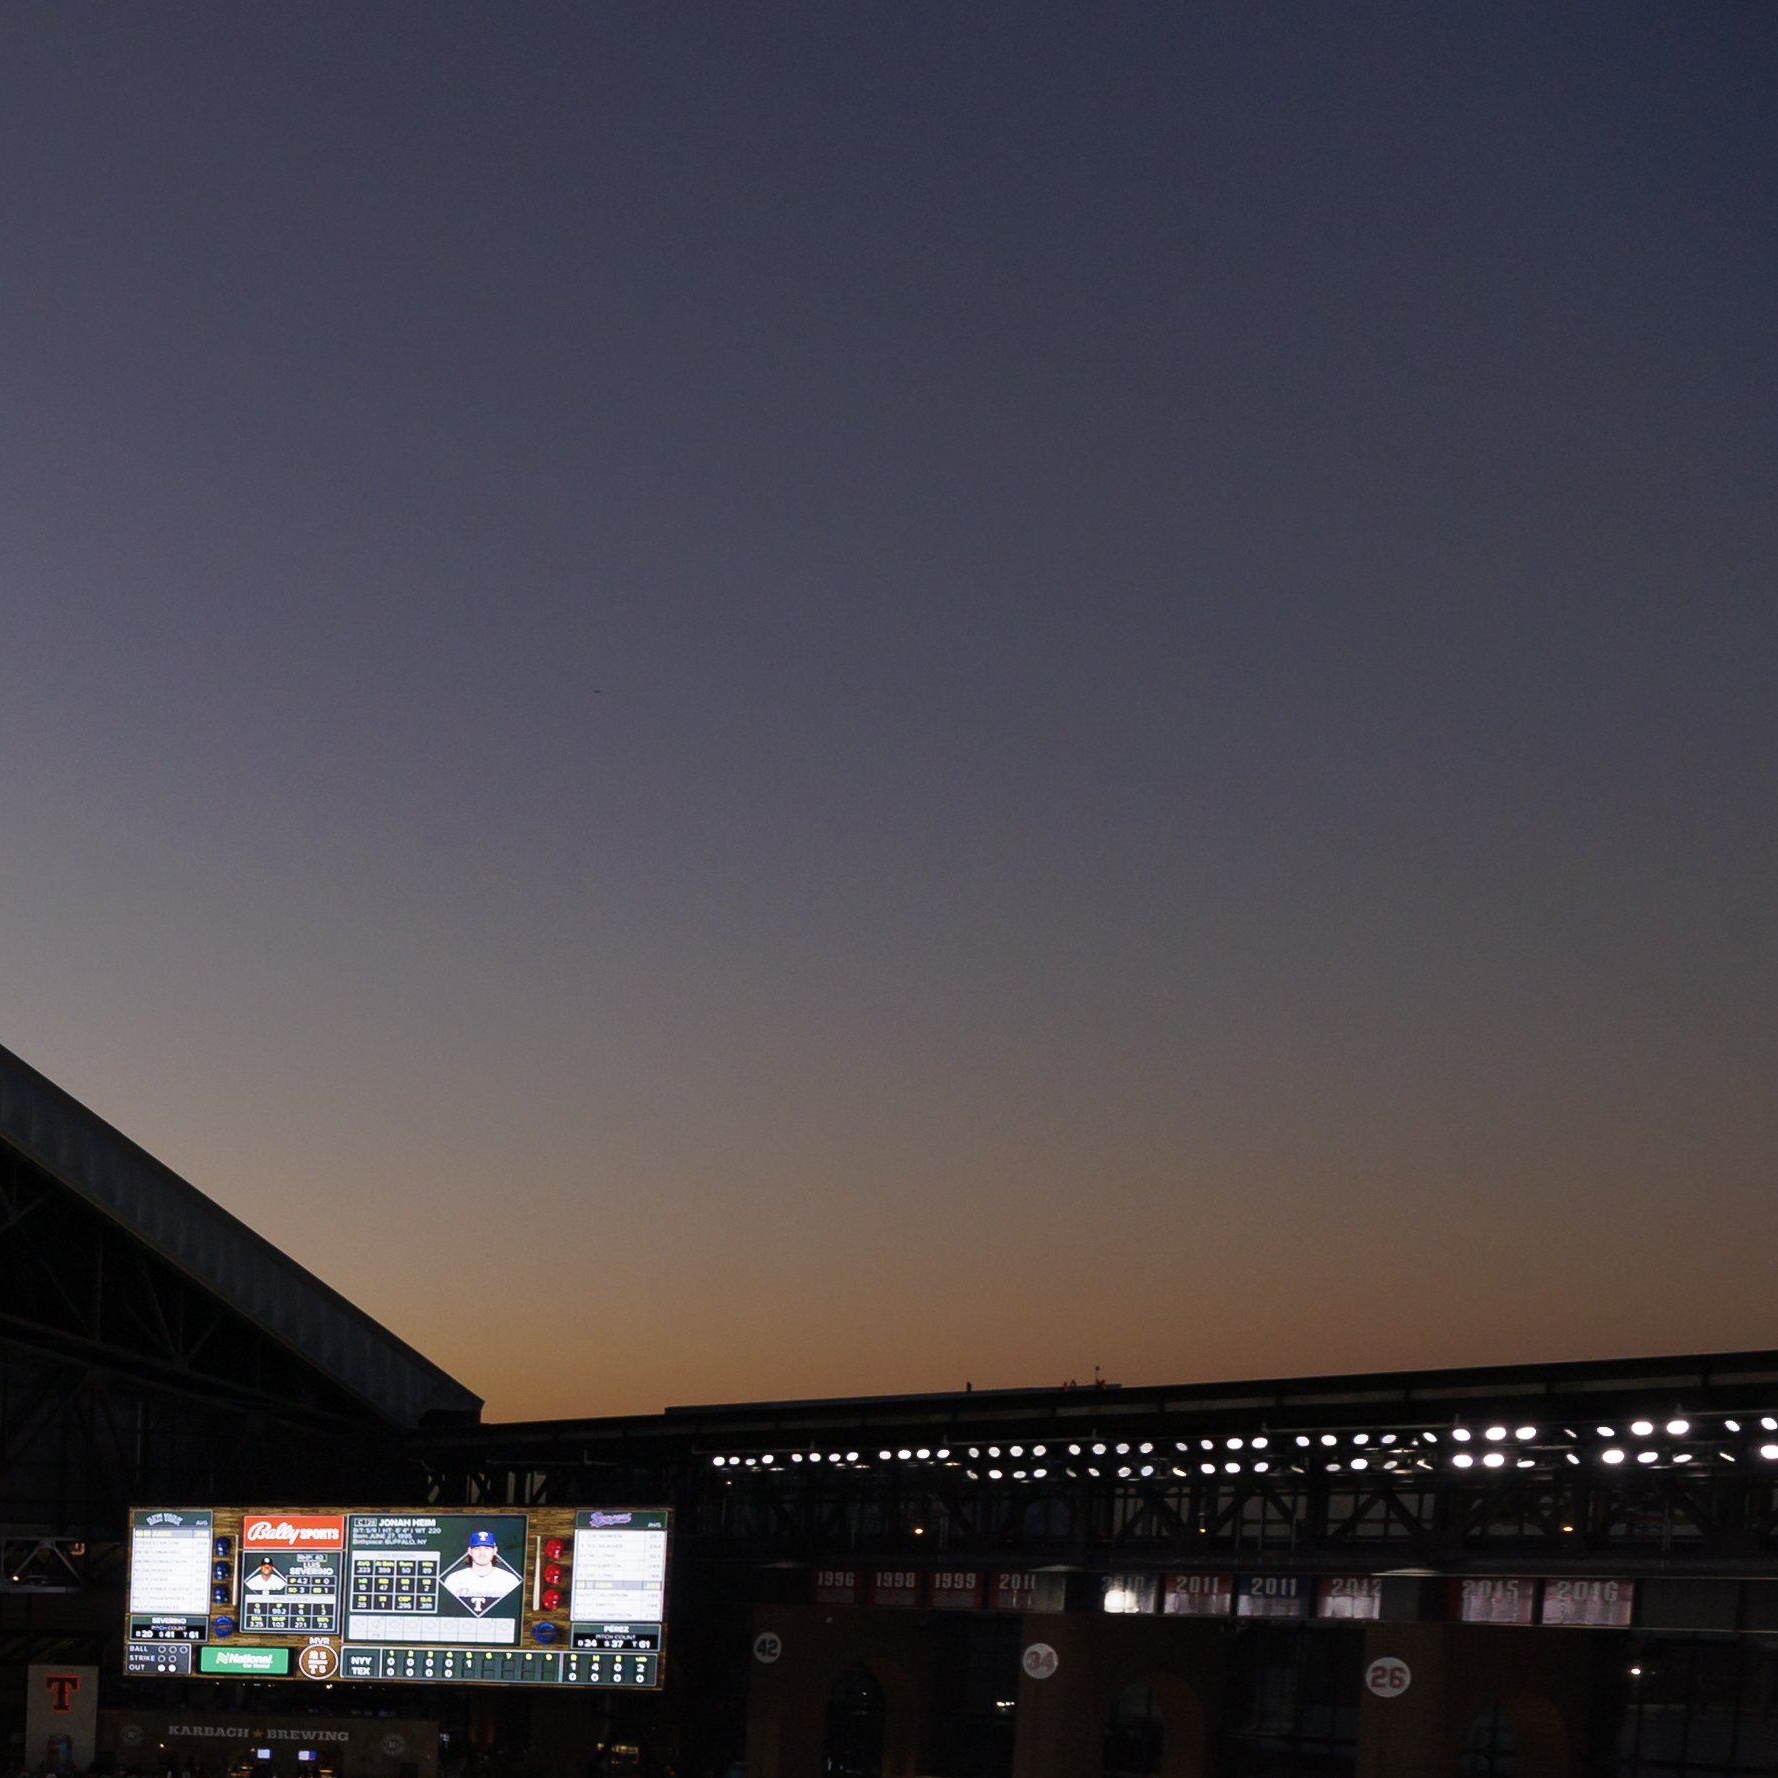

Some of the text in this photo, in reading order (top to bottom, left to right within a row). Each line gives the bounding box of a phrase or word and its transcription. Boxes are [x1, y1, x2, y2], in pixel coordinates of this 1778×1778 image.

[379, 1518, 412, 1527] JONAH
[412, 1518, 436, 1527] HEIM
[247, 1521, 340, 1545] Bally SPORTS
[817, 1571, 855, 1587] 1996
[876, 1572, 916, 1588] 1998
[935, 1572, 976, 1589] 1999
[1176, 1576, 1219, 1594] 2011
[1250, 1576, 1297, 1597] 2011
[1461, 1579, 1519, 1600] 2015
[1556, 1579, 1619, 1601] 2016
[151, 1617, 187, 1625] SEVERINO
[141, 1630, 154, 1638] 20
[164, 1630, 175, 1639] 41
[611, 1640, 624, 1648] 37
[757, 1638, 779, 1657] 42
[350, 1656, 372, 1665] NYY
[386, 1657, 395, 1667] 0
[406, 1657, 415, 1667] 0
[425, 1658, 434, 1667] 0
[445, 1658, 453, 1668] 0
[614, 1663, 622, 1672] 0
[636, 1664, 645, 1672] 2
[1026, 1650, 1056, 1671] 34
[352, 1667, 644, 1683] TEX 0 0 0 0 0 0 0 0
[1371, 1665, 1405, 1689] 26
[46, 1675, 79, 1712] T
[168, 1725, 349, 1742] KARBACH BREWING
